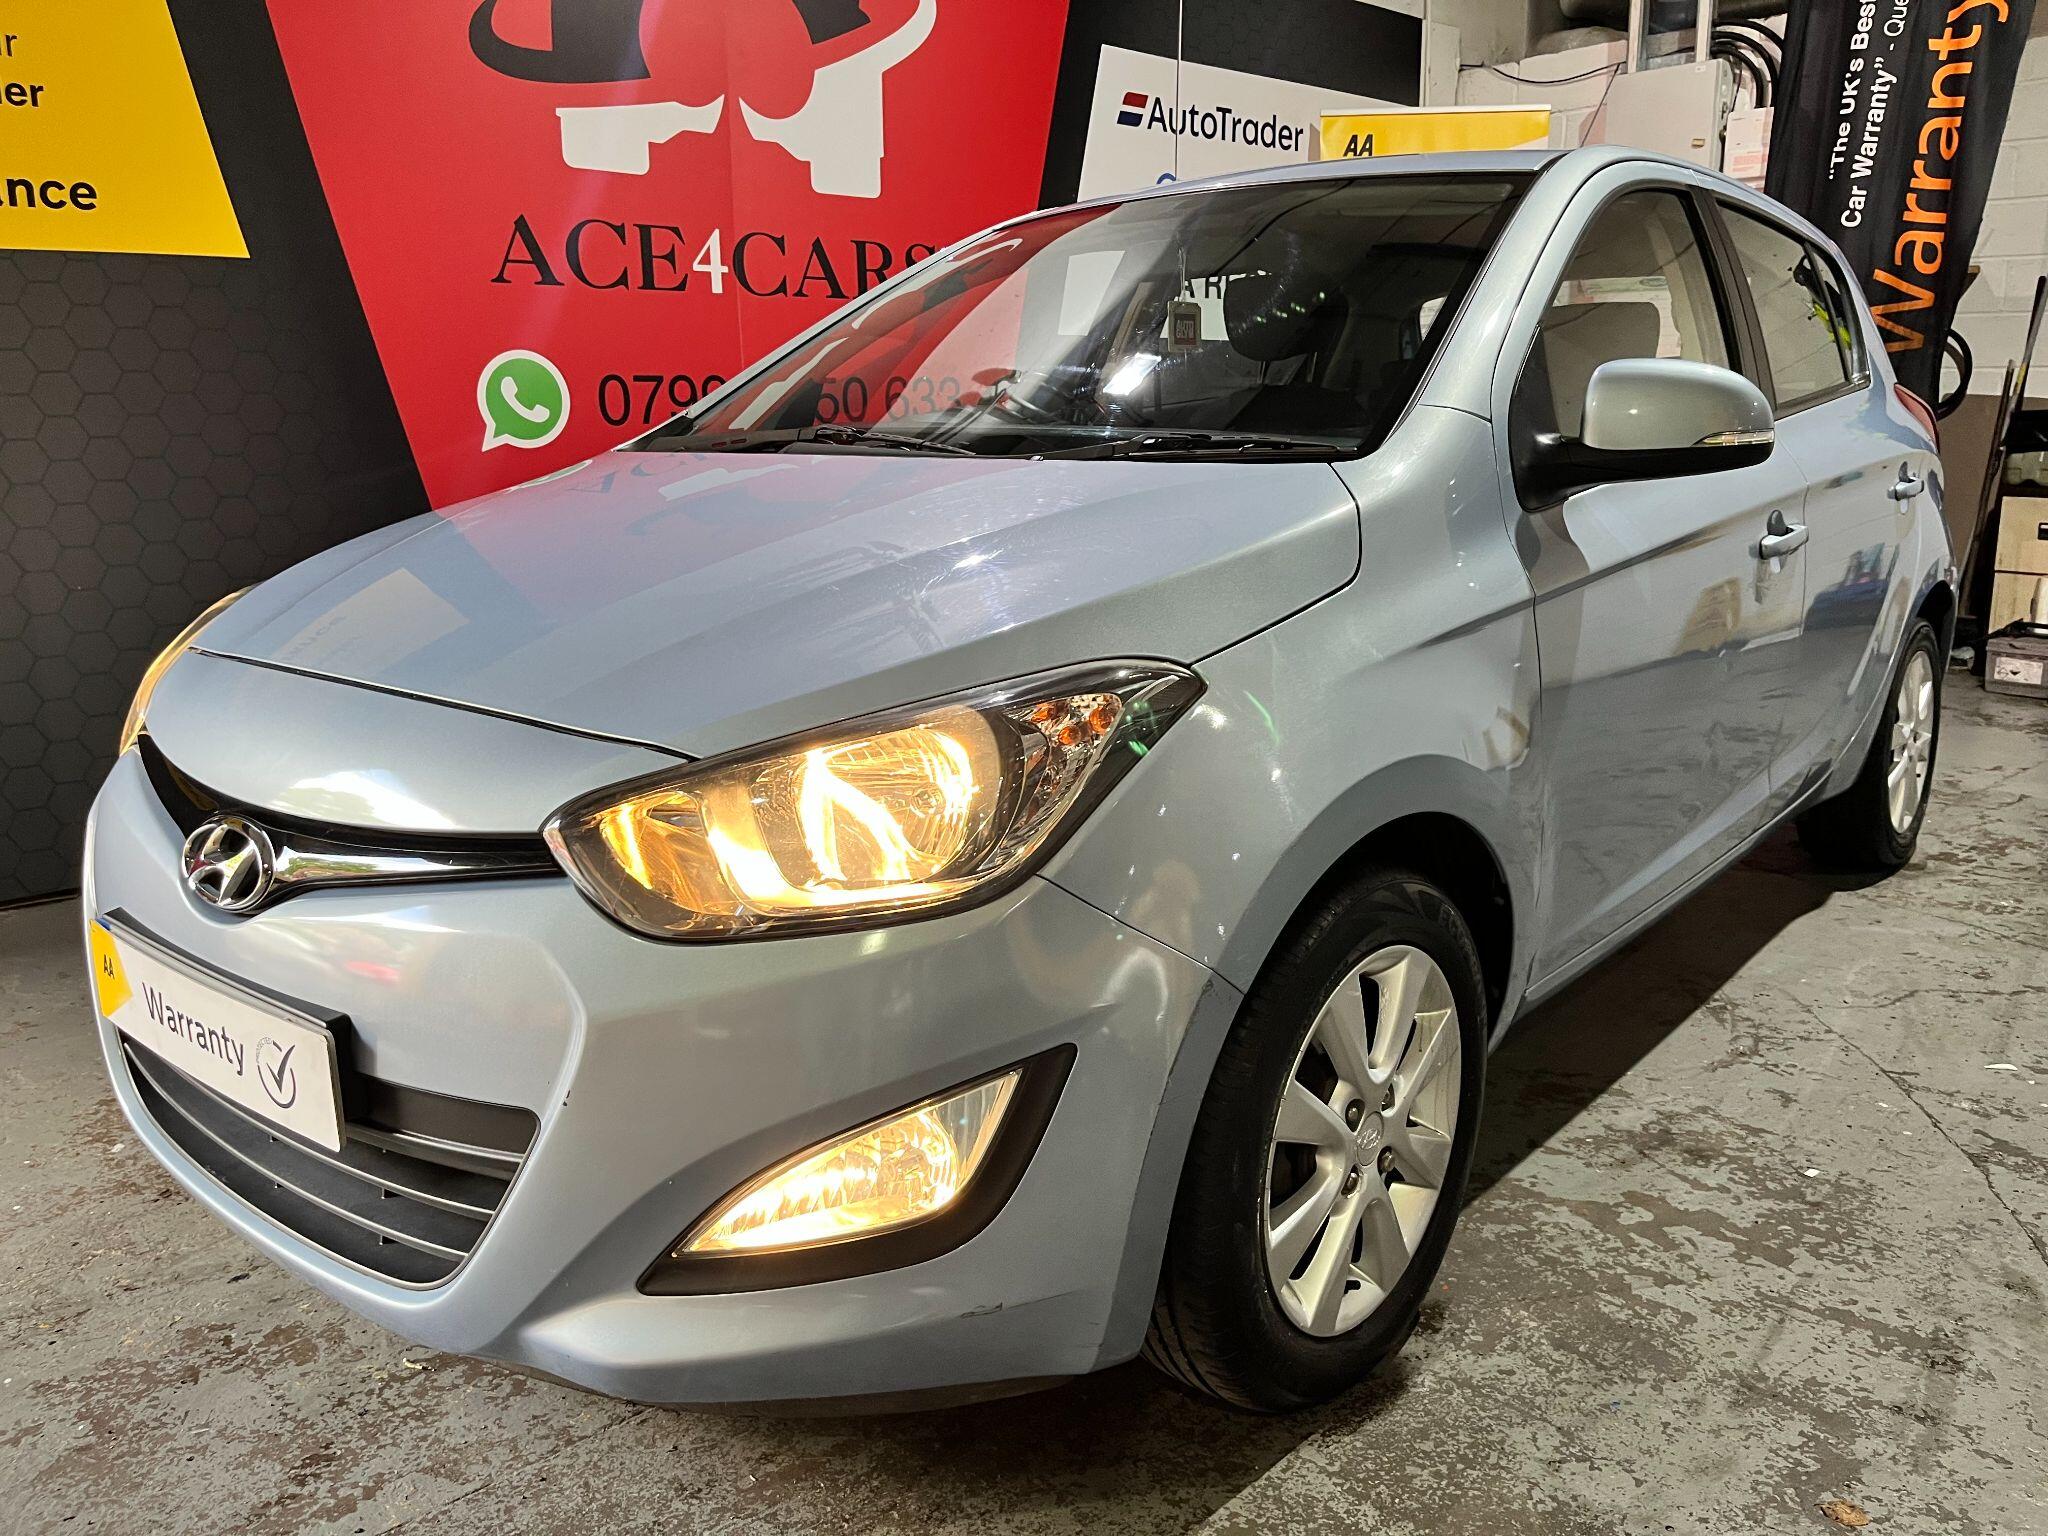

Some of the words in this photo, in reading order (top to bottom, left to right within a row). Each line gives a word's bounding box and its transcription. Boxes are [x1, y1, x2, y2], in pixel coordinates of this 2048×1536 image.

[0, 82, 44, 107] er
[1146, 96, 1304, 153] AutoTrader
[1342, 134, 1375, 157] AA
[0, 178, 97, 210] nce
[1841, 185, 1868, 228] Car
[103, 954, 116, 980] AA
[141, 981, 246, 1076] Warranty
